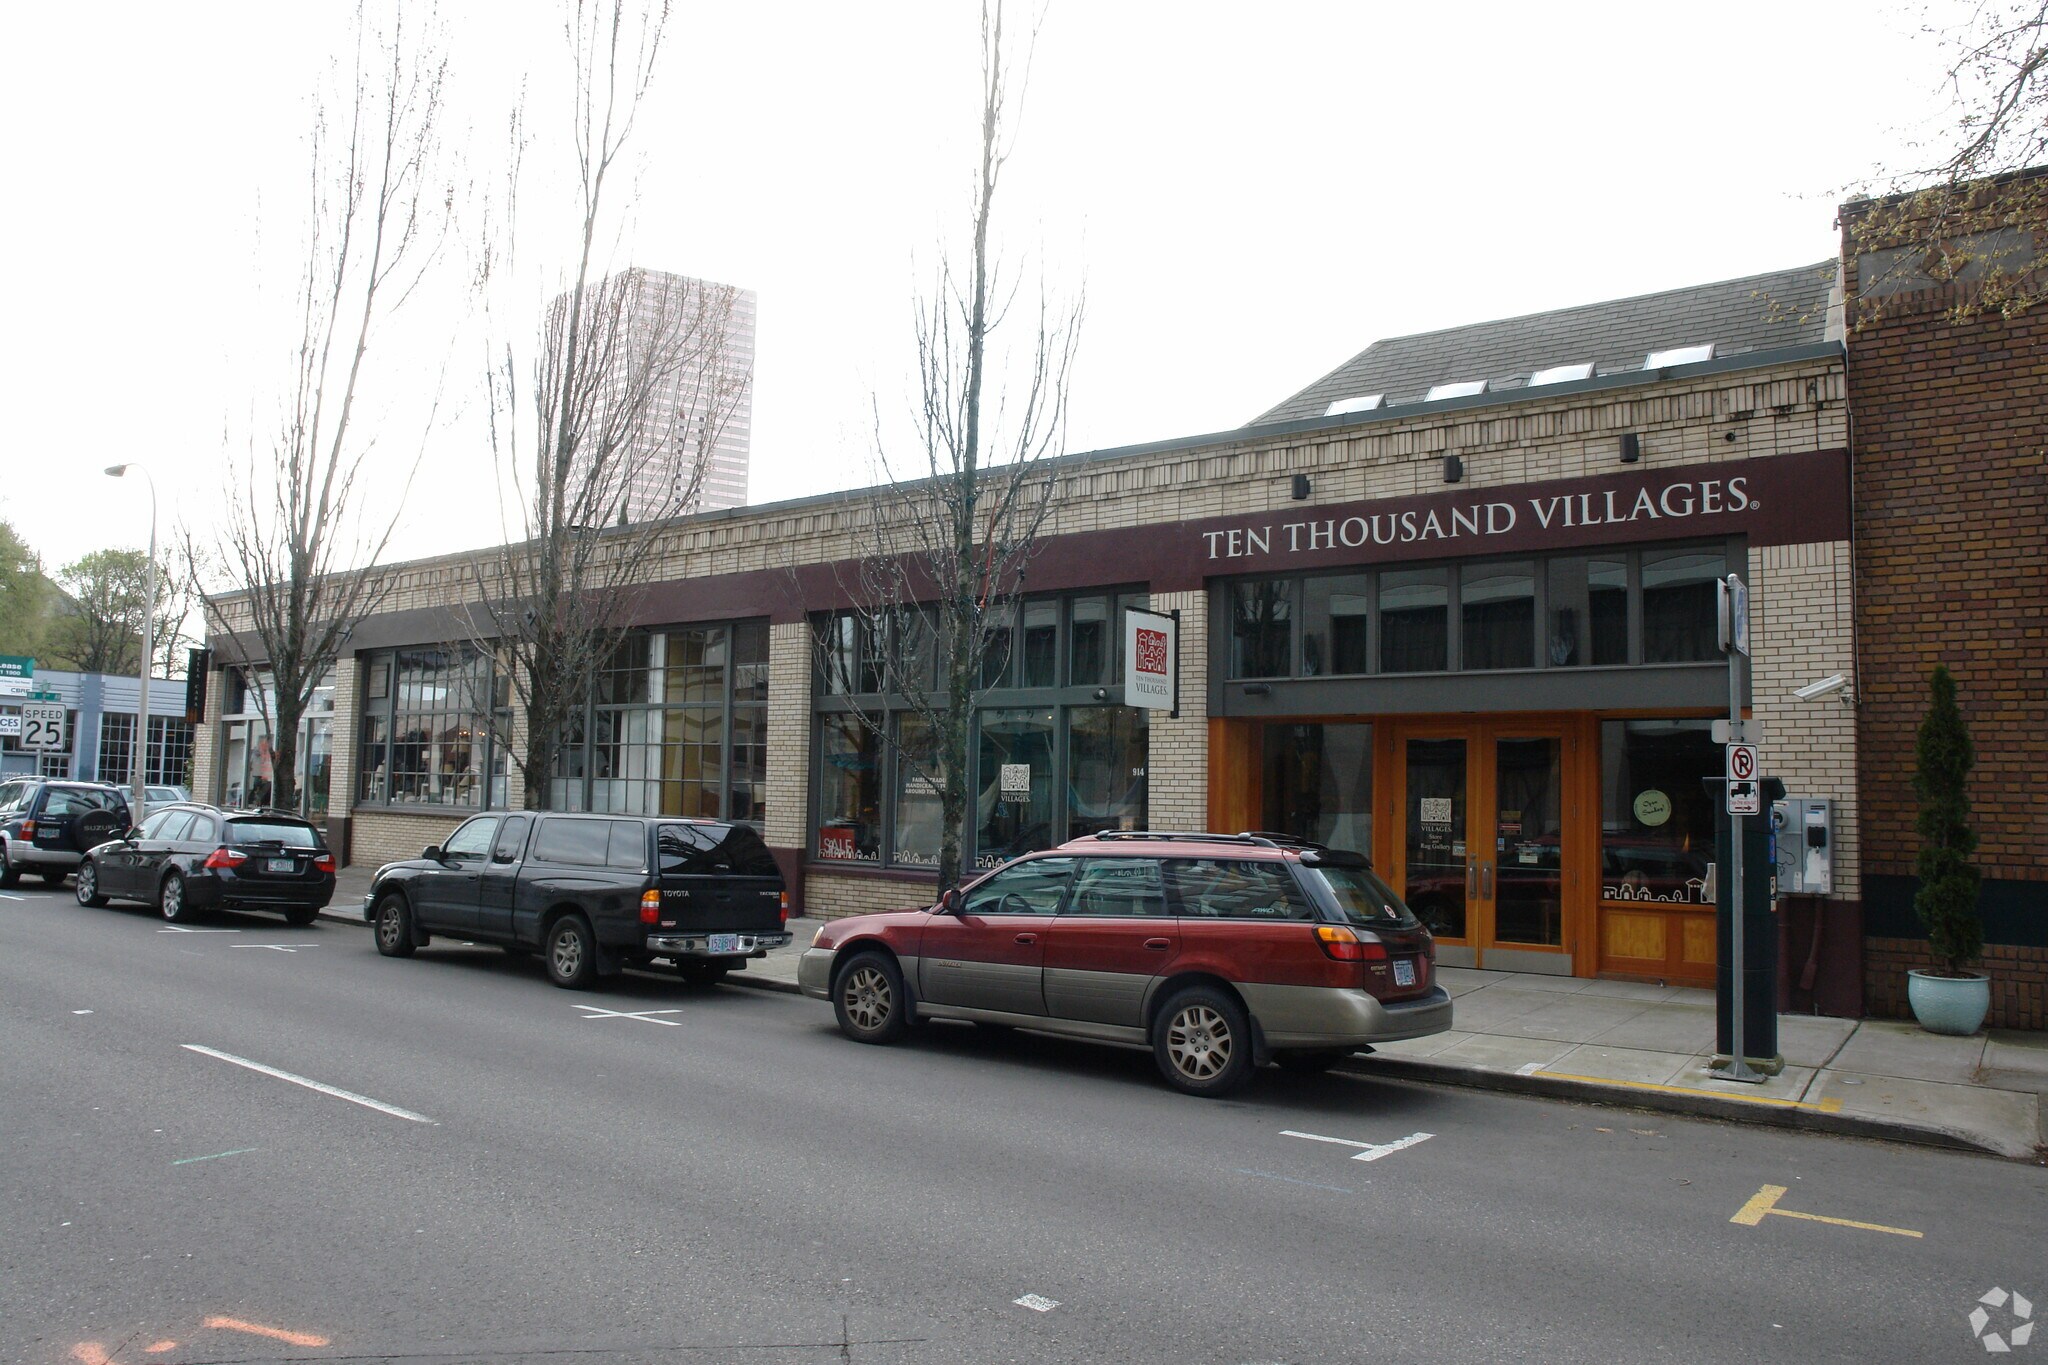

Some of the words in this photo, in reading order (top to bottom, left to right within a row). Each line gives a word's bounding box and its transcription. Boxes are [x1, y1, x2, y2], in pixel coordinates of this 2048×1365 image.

[1202, 526, 1272, 559] TEN
[1283, 503, 1517, 552] THOUSAND
[25, 709, 63, 719] SPEED
[25, 720, 61, 745] 25
[1132, 767, 1144, 776] 914
[83, 824, 117, 832] SUZUKI
[823, 837, 852, 855] SALE
[662, 889, 690, 898] TOYOTA
